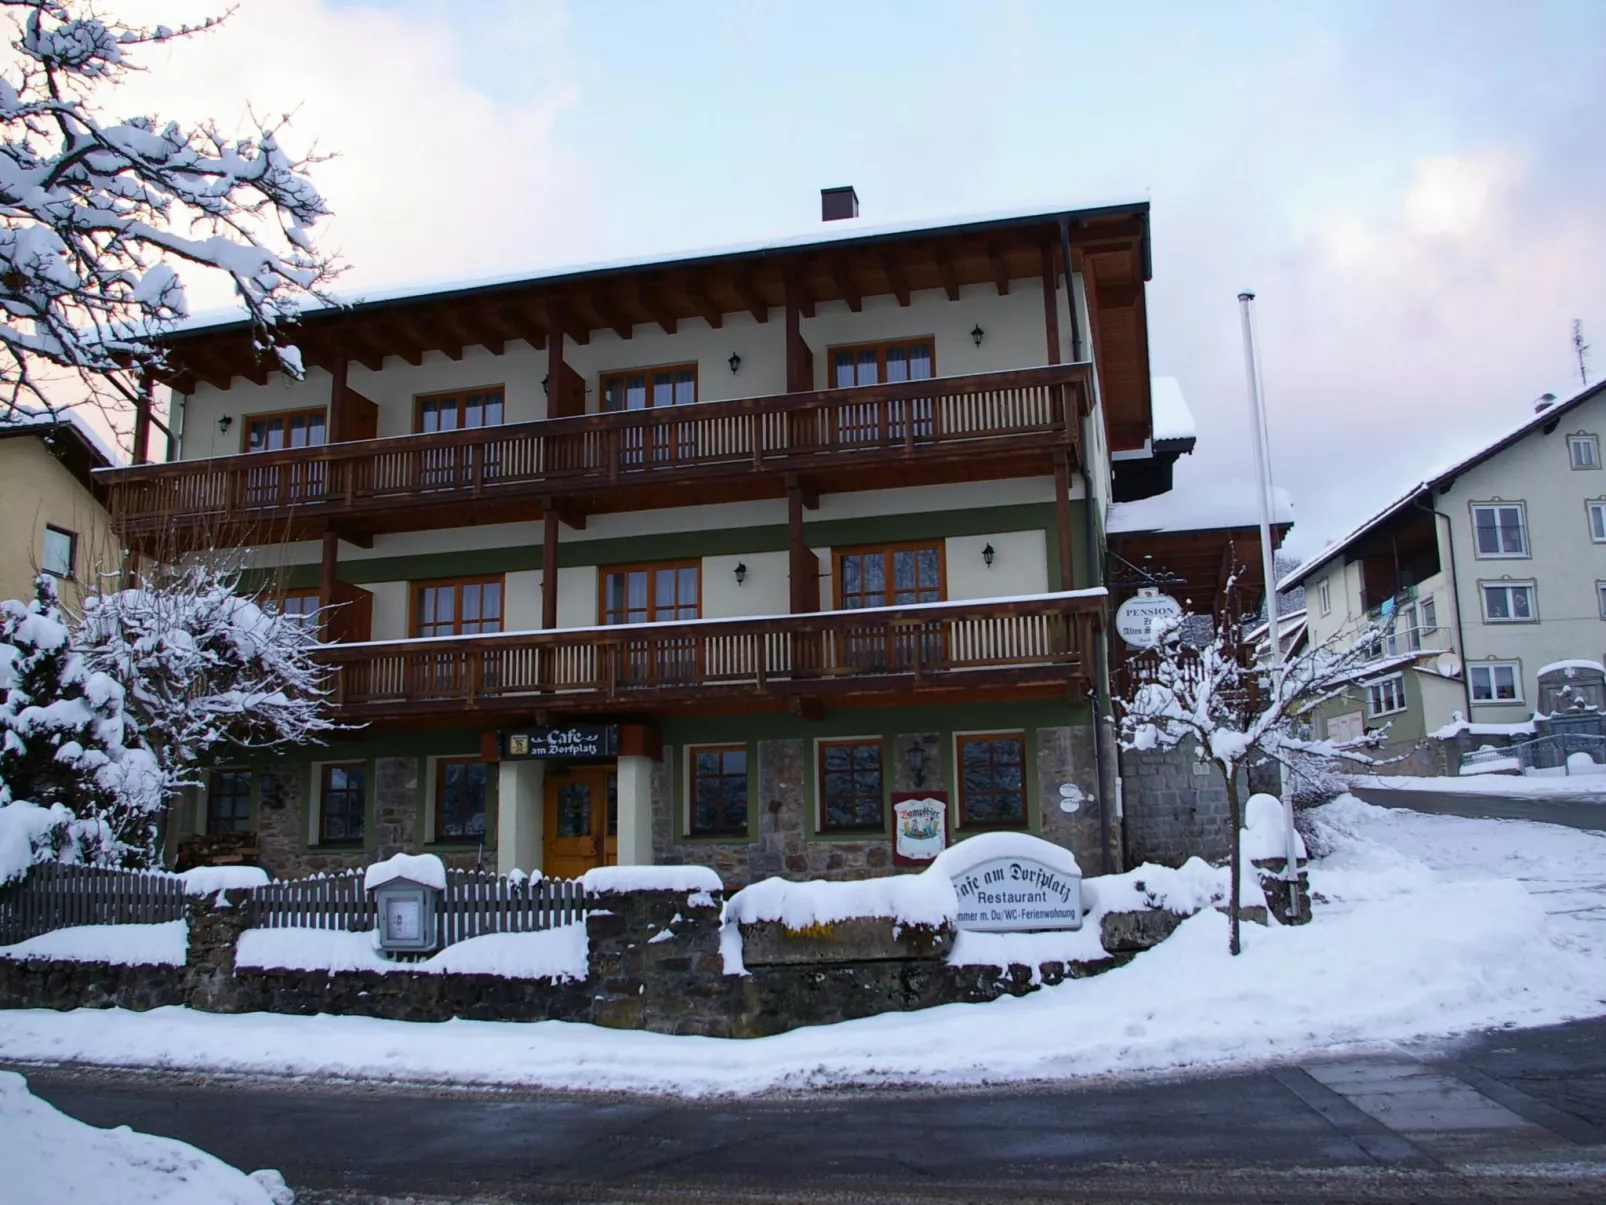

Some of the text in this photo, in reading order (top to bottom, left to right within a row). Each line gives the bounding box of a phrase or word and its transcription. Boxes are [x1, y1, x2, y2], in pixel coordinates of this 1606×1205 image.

[1126, 607, 1174, 617] PENSION
[547, 728, 582, 744] Cafe
[531, 743, 597, 755] am Dorfplatz
[953, 862, 1071, 903] afe am Dorfplatz
[977, 891, 1047, 904] Restaurant
[956, 912, 978, 922] mmer
